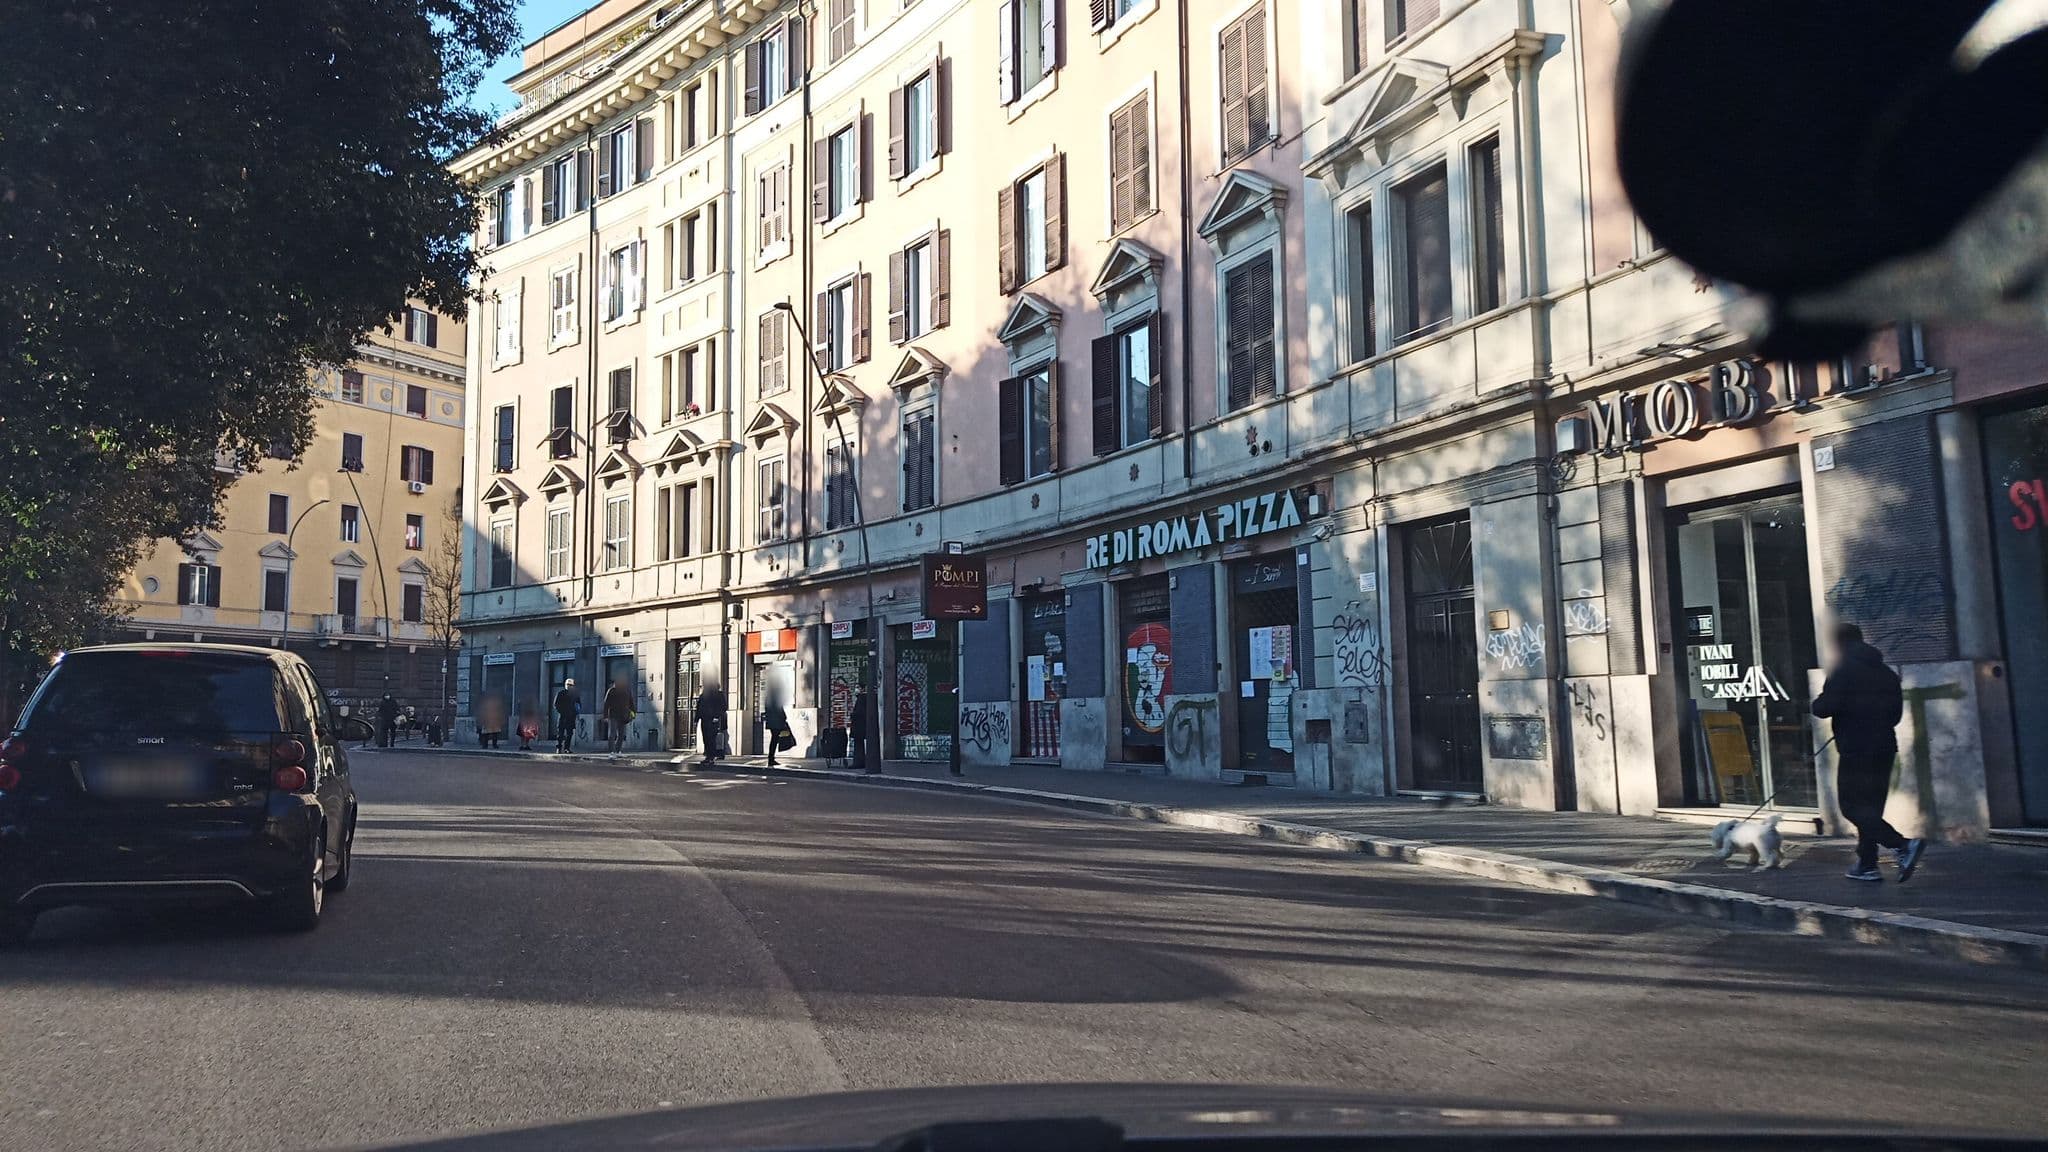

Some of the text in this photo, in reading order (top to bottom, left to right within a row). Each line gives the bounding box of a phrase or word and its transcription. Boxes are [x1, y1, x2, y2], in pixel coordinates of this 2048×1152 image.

[1086, 489, 1302, 569] RE DI ROMA PIZZA
[934, 569, 979, 582] POMPI
[913, 622, 932, 632] SIMPLY
[1692, 643, 1733, 660] IVANI
[1694, 664, 1739, 681] OBILI
